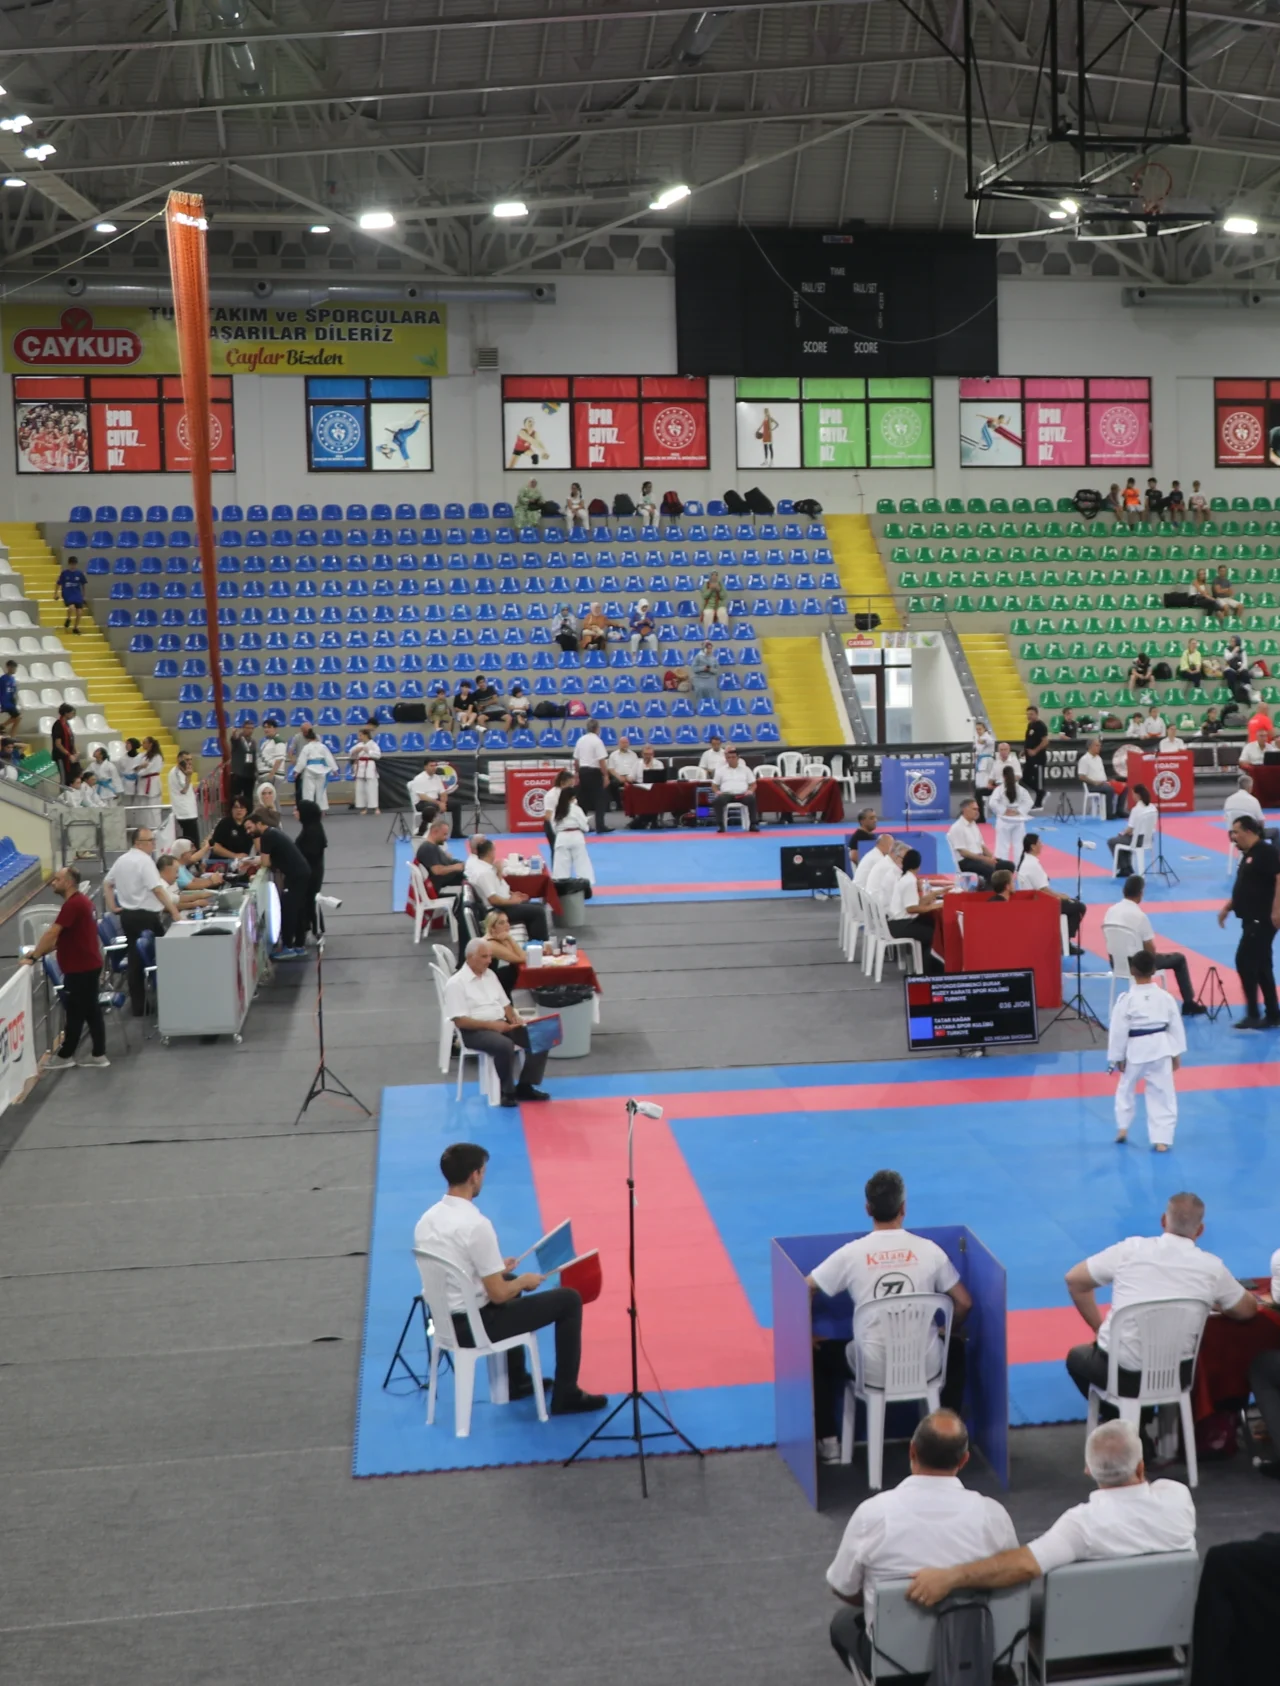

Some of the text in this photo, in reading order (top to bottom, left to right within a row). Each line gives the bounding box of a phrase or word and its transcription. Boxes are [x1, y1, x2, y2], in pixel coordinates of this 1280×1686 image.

[276, 311, 297, 322] ve
[306, 309, 440, 324] SPORCULARA
[209, 324, 393, 343] AŞARILAR DİLERİZ
[22, 336, 134, 361] ÇAYKUR
[803, 341, 828, 353] SCORE
[854, 342, 878, 354] SCORE
[226, 347, 344, 371] Çaylar Bizden
